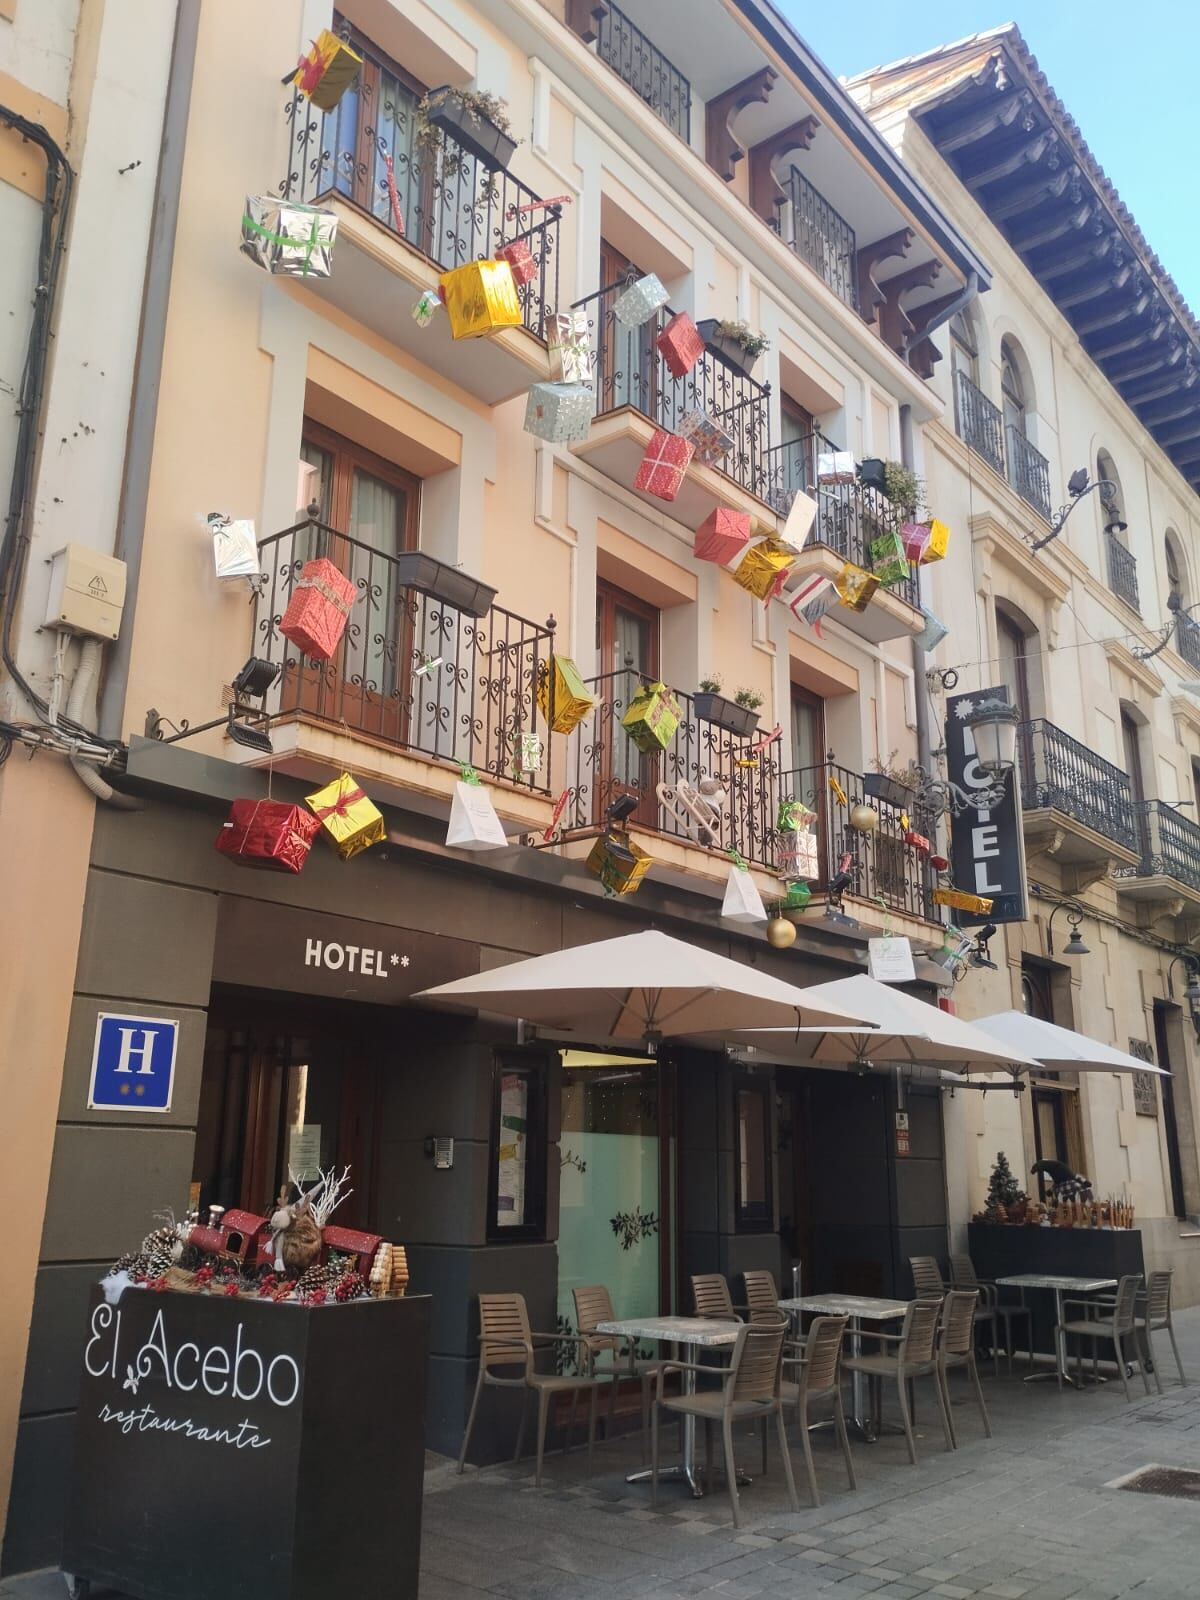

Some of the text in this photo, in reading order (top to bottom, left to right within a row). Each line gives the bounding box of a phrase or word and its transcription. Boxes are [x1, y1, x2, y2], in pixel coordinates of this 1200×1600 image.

[963, 725, 1002, 894] OEL
[113, 1027, 159, 1075] H
[84, 1303, 299, 1406] El Acebo
[98, 1403, 271, 1449] restaurante
